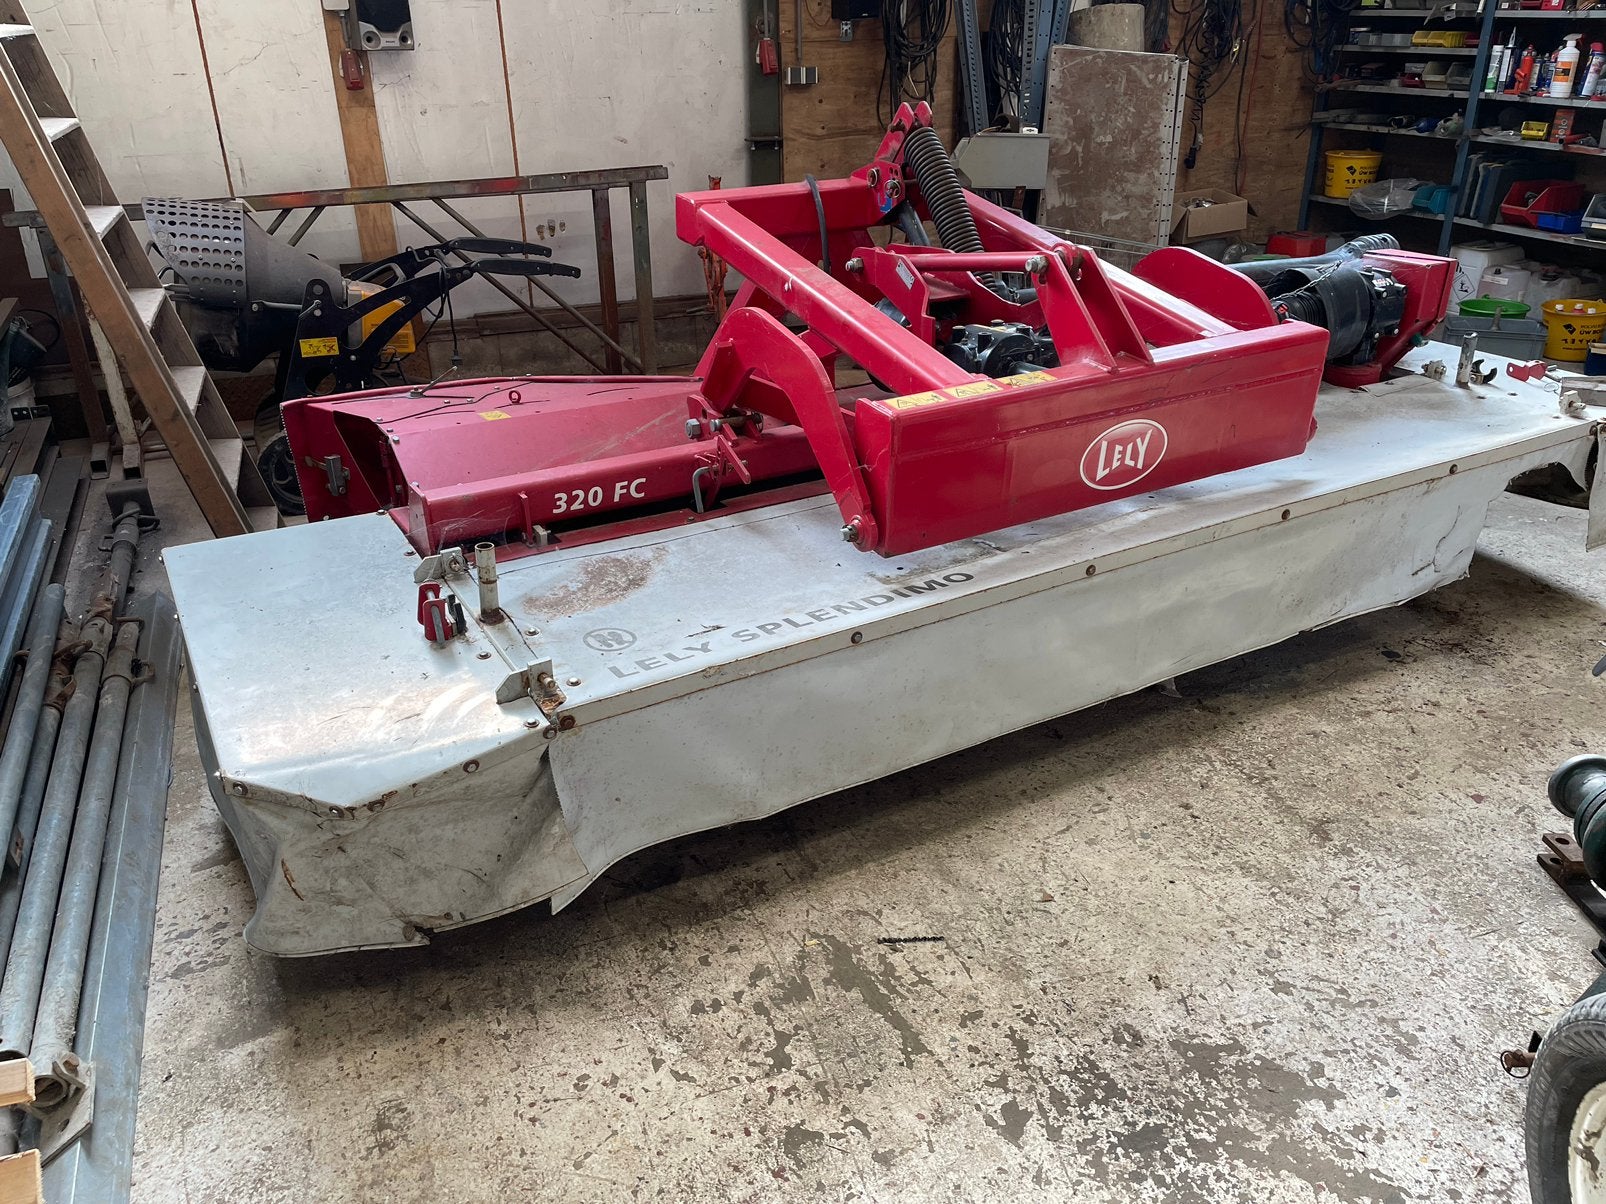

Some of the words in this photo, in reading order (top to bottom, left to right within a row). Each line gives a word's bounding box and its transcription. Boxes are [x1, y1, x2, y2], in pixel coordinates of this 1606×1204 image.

[1095, 428, 1153, 482] LELY
[552, 485, 604, 514] 320
[613, 477, 647, 503] FC
[607, 641, 713, 679] LELY
[730, 572, 976, 643] SPLENDIMO
